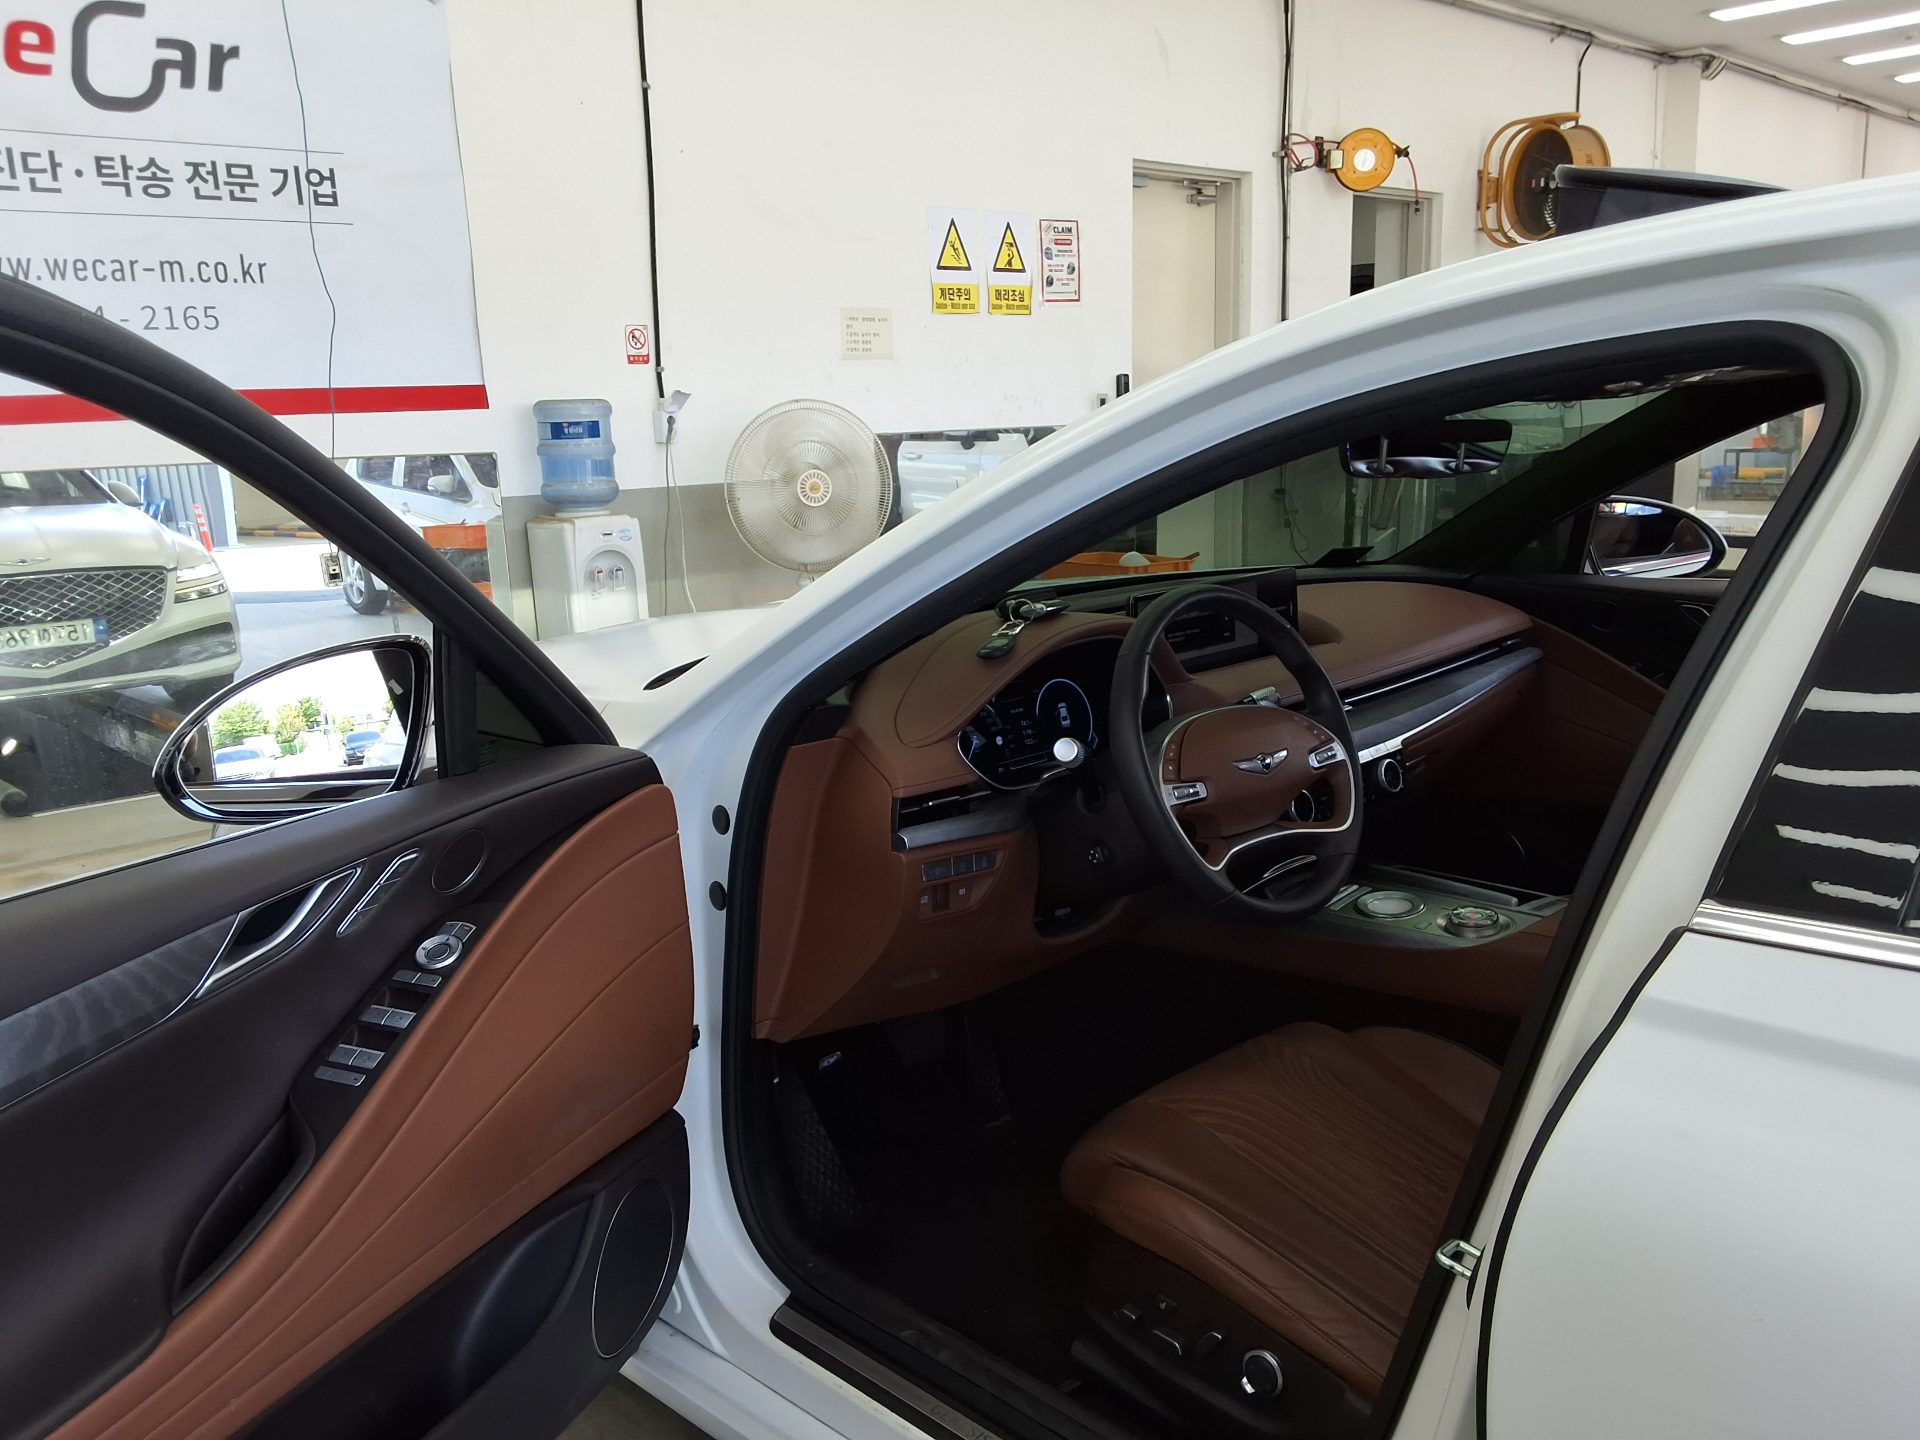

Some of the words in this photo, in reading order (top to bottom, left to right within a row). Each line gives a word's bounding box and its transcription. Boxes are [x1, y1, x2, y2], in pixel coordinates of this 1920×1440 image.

[184, 160, 259, 202] 전문
[269, 165, 340, 207] 기업
[1053, 226, 1073, 234] CLAIM
[0, 254, 267, 284] w.wecar-m.co.kr
[939, 288, 971, 301] 계단주의
[995, 289, 1025, 302] 머리조심
[140, 305, 220, 331] 2165
